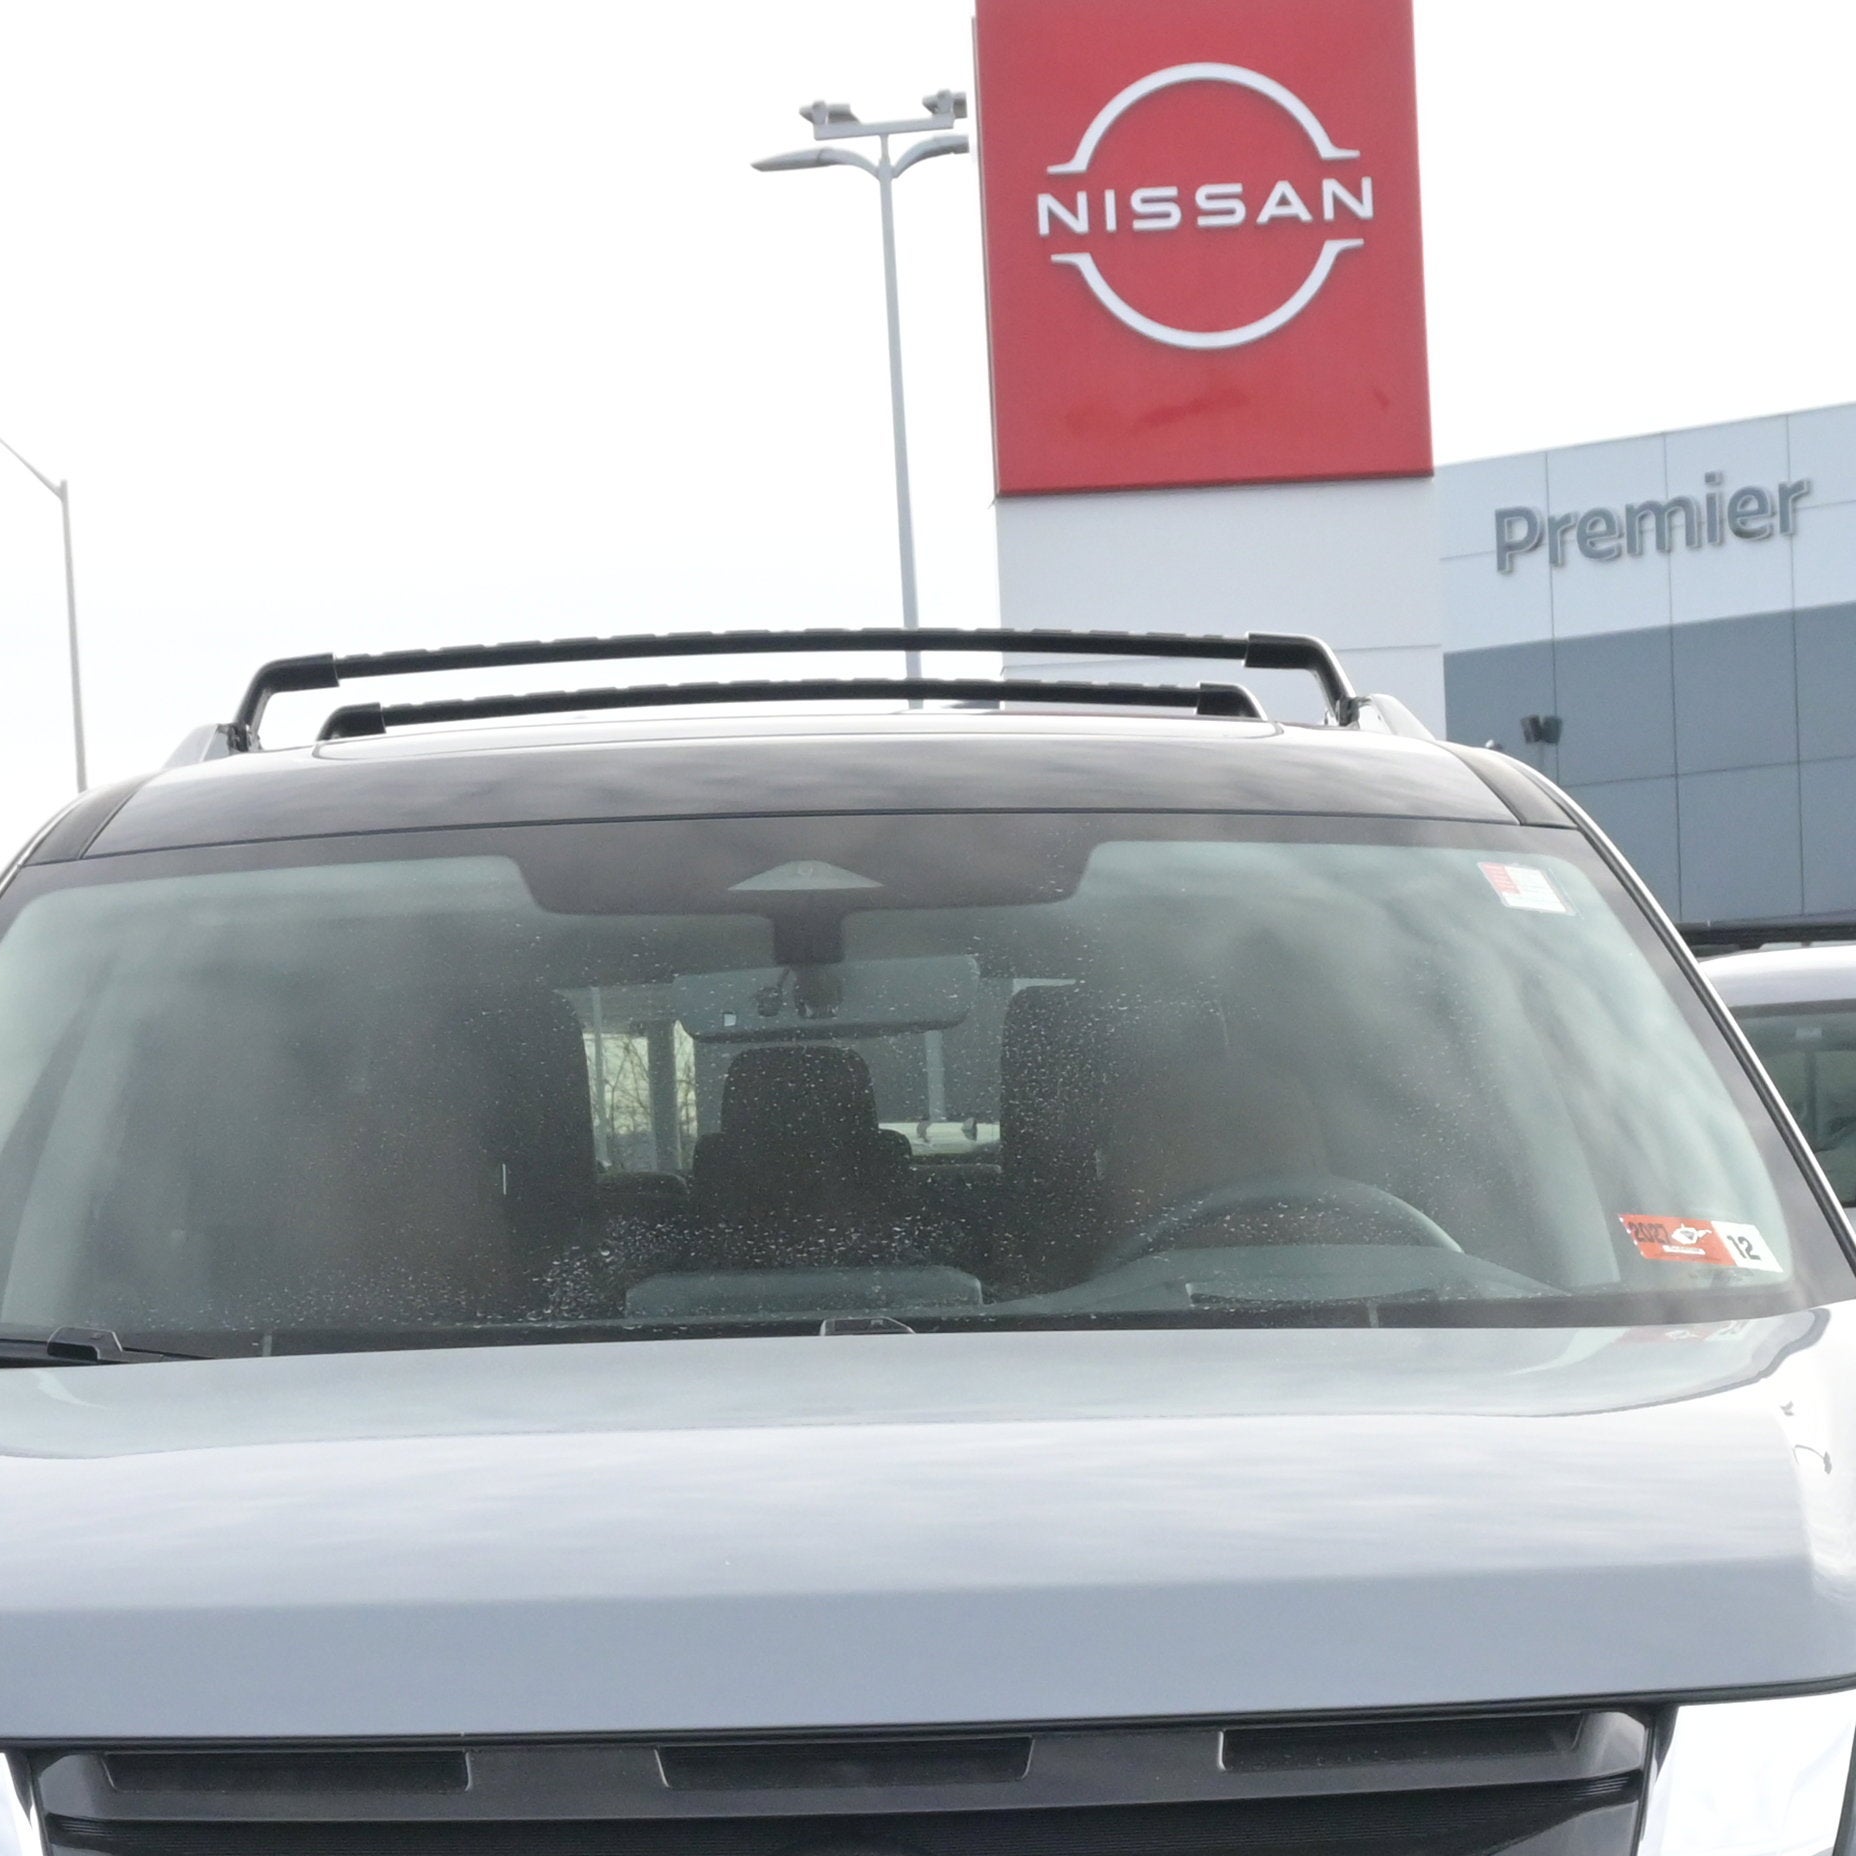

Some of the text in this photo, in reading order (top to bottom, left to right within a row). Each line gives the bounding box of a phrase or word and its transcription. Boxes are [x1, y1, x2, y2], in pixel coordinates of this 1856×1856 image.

[1037, 176, 1373, 236] NISSAN
[1494, 470, 1812, 574] Premier
[1727, 1234, 1762, 1260] 12
